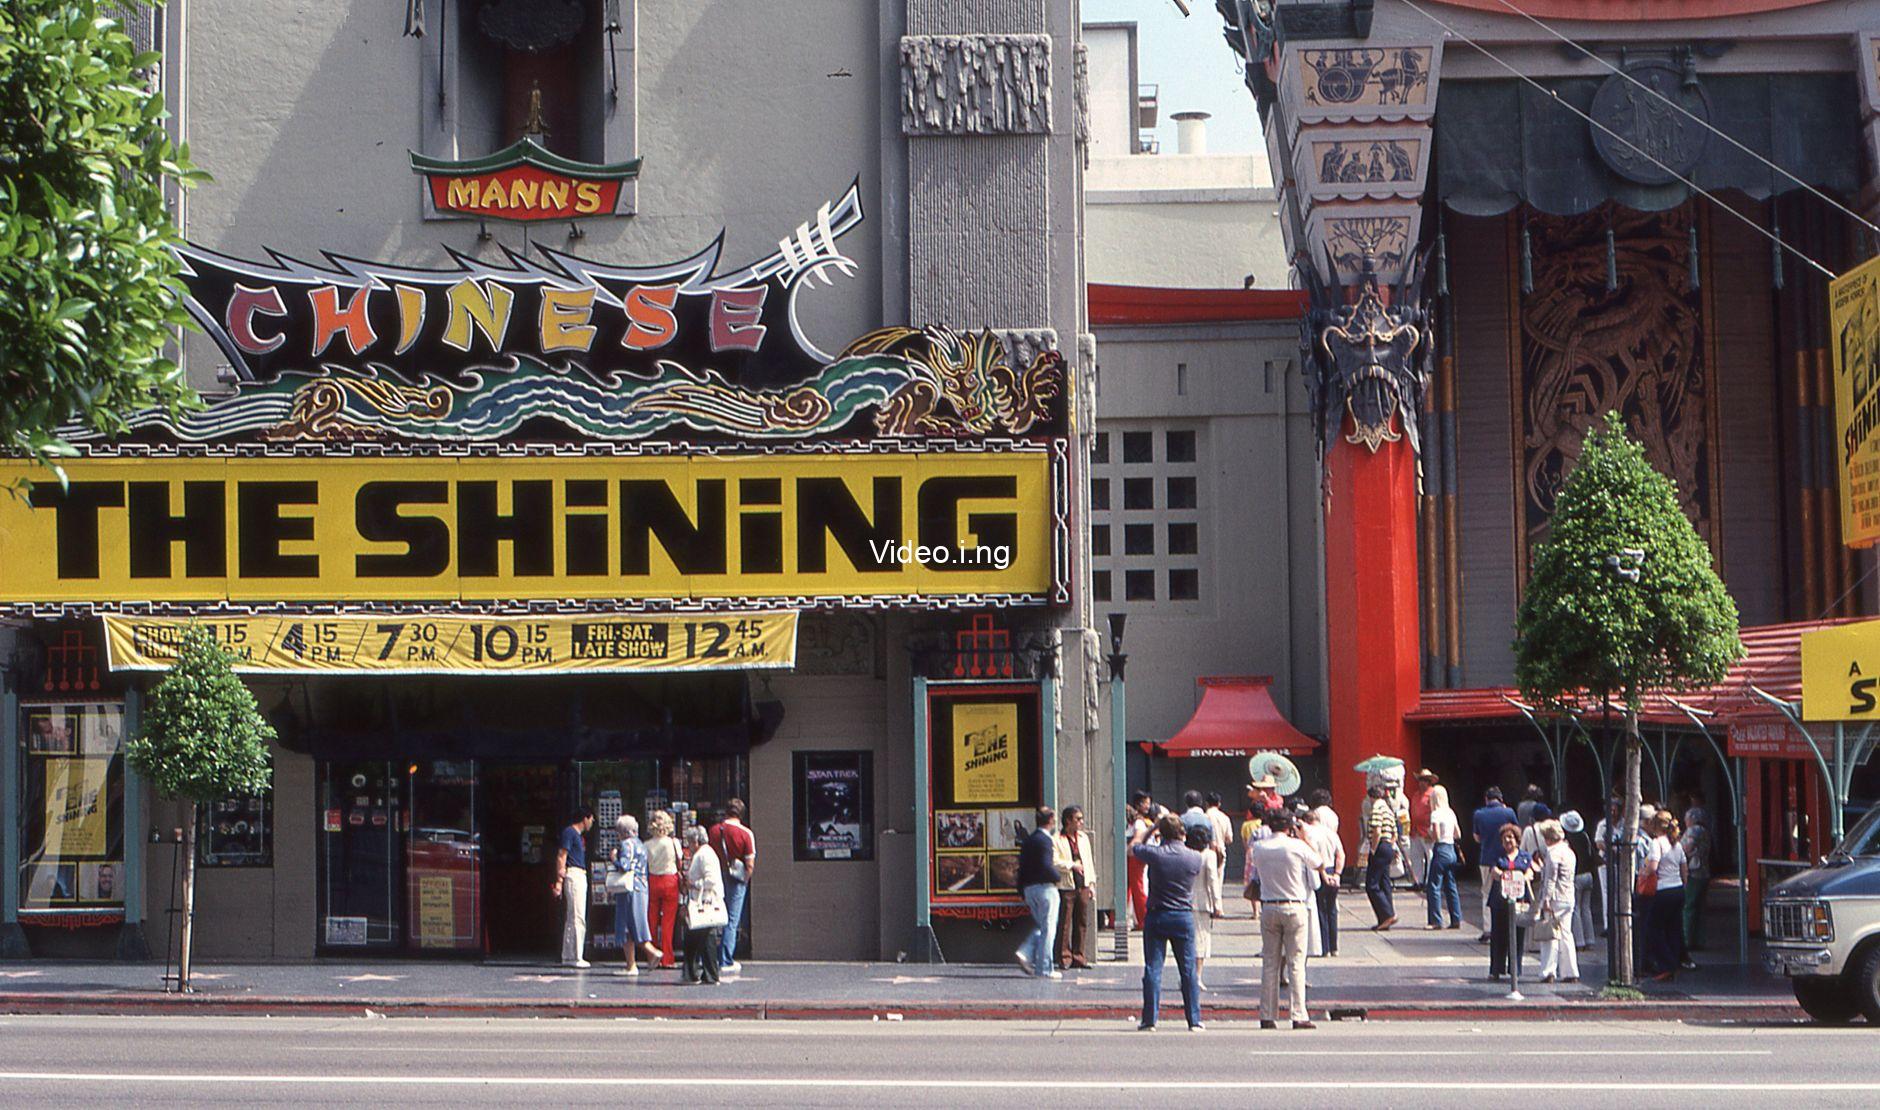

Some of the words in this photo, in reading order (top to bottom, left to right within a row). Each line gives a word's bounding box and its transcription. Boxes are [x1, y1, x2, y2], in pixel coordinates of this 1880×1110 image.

[447, 177, 601, 213] MANN'S
[226, 277, 768, 357] CHINESE
[28, 479, 320, 578] THE
[224, 623, 248, 644] 15
[281, 623, 308, 660] 4
[313, 623, 338, 643] 15
[377, 623, 406, 660] 7
[410, 622, 438, 642] 30
[470, 623, 519, 662] 10
[526, 624, 550, 643] 15
[684, 621, 731, 659] 12
[734, 619, 764, 639] 45
[312, 646, 346, 662] P.M.
[407, 646, 439, 661] P.M.
[521, 647, 557, 663] P.M.
[574, 641, 615, 658] LATE
[617, 640, 665, 657] SHOW
[734, 642, 769, 658] A.M.
[1848, 660, 1862, 677] A
[1850, 678, 1880, 715] S
[1190, 748, 1246, 758] SNACK
[807, 769, 833, 779] STAR
[834, 769, 858, 779] TREK
